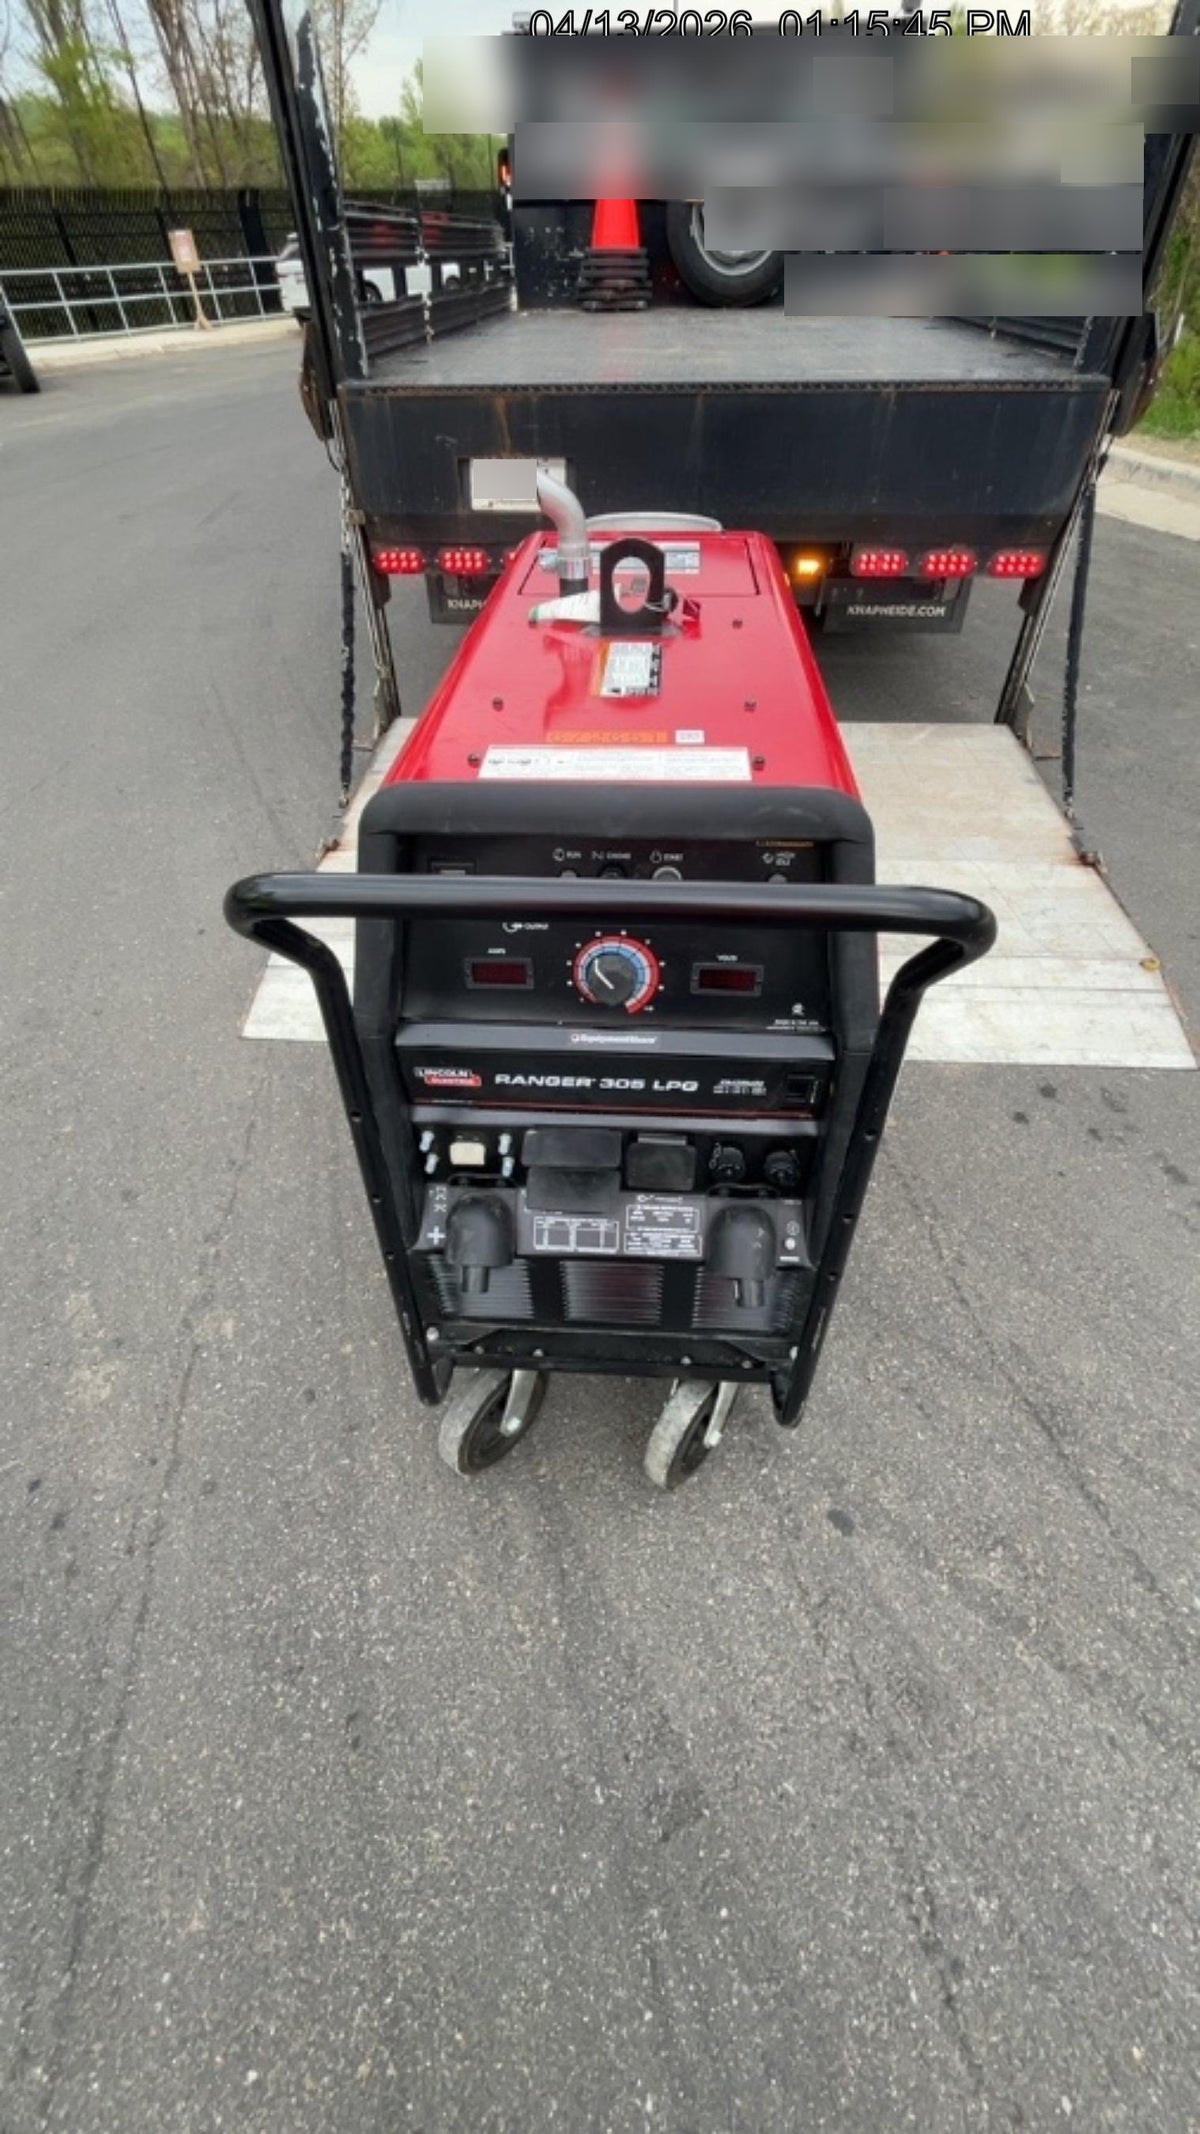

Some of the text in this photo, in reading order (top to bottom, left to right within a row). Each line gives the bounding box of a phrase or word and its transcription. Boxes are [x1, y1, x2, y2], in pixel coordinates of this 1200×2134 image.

[847, 604, 946, 617] KNAPHEIDE.COM
[599, 1077, 646, 1090] 305
[652, 1079, 700, 1092] LPG
